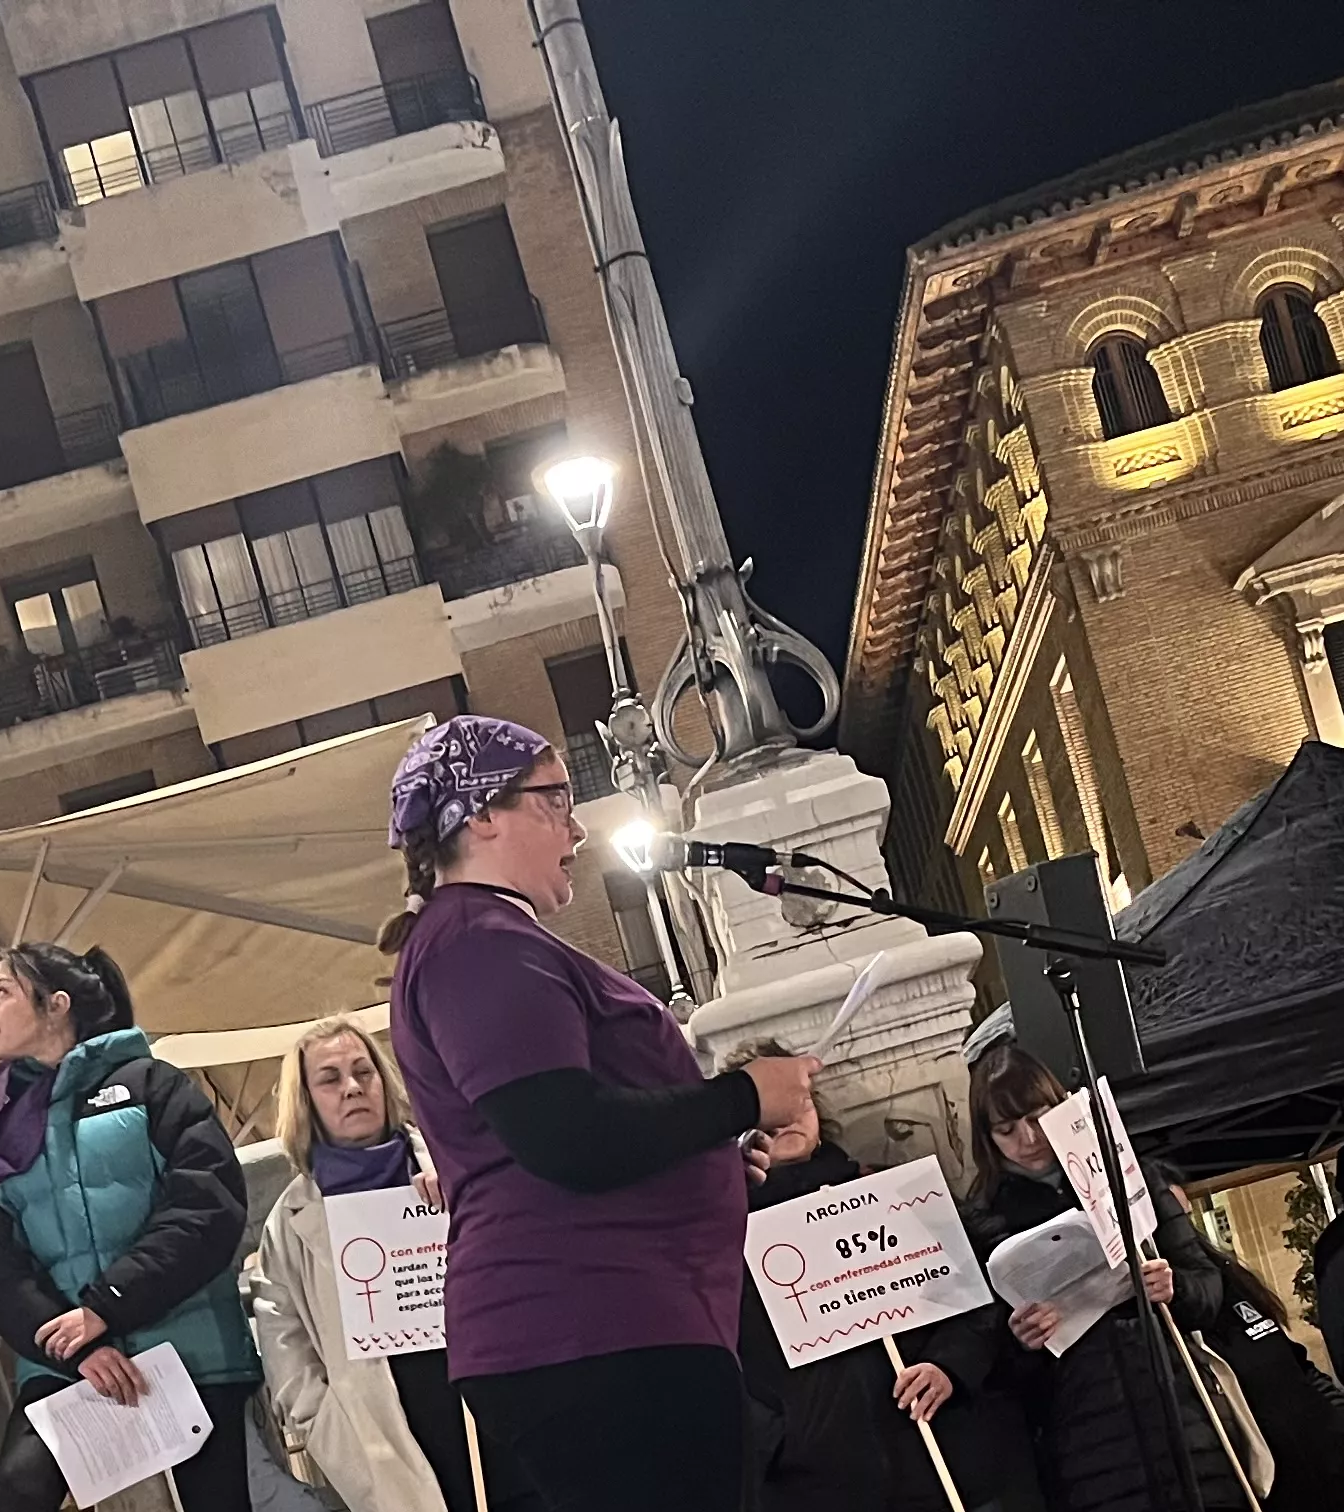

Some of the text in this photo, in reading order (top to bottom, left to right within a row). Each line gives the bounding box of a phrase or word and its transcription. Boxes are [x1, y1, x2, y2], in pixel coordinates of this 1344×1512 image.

[806, 1192, 879, 1223] ARCADIA
[835, 1224, 898, 1259] 85%
[391, 1248, 413, 1257] con
[392, 1263, 428, 1273] tardan
[809, 1242, 943, 1292] con enfermedad mental
[395, 1278, 414, 1287] que
[417, 1275, 433, 1283] los
[819, 1265, 950, 1315] no tiene empleo
[396, 1290, 420, 1301] para
